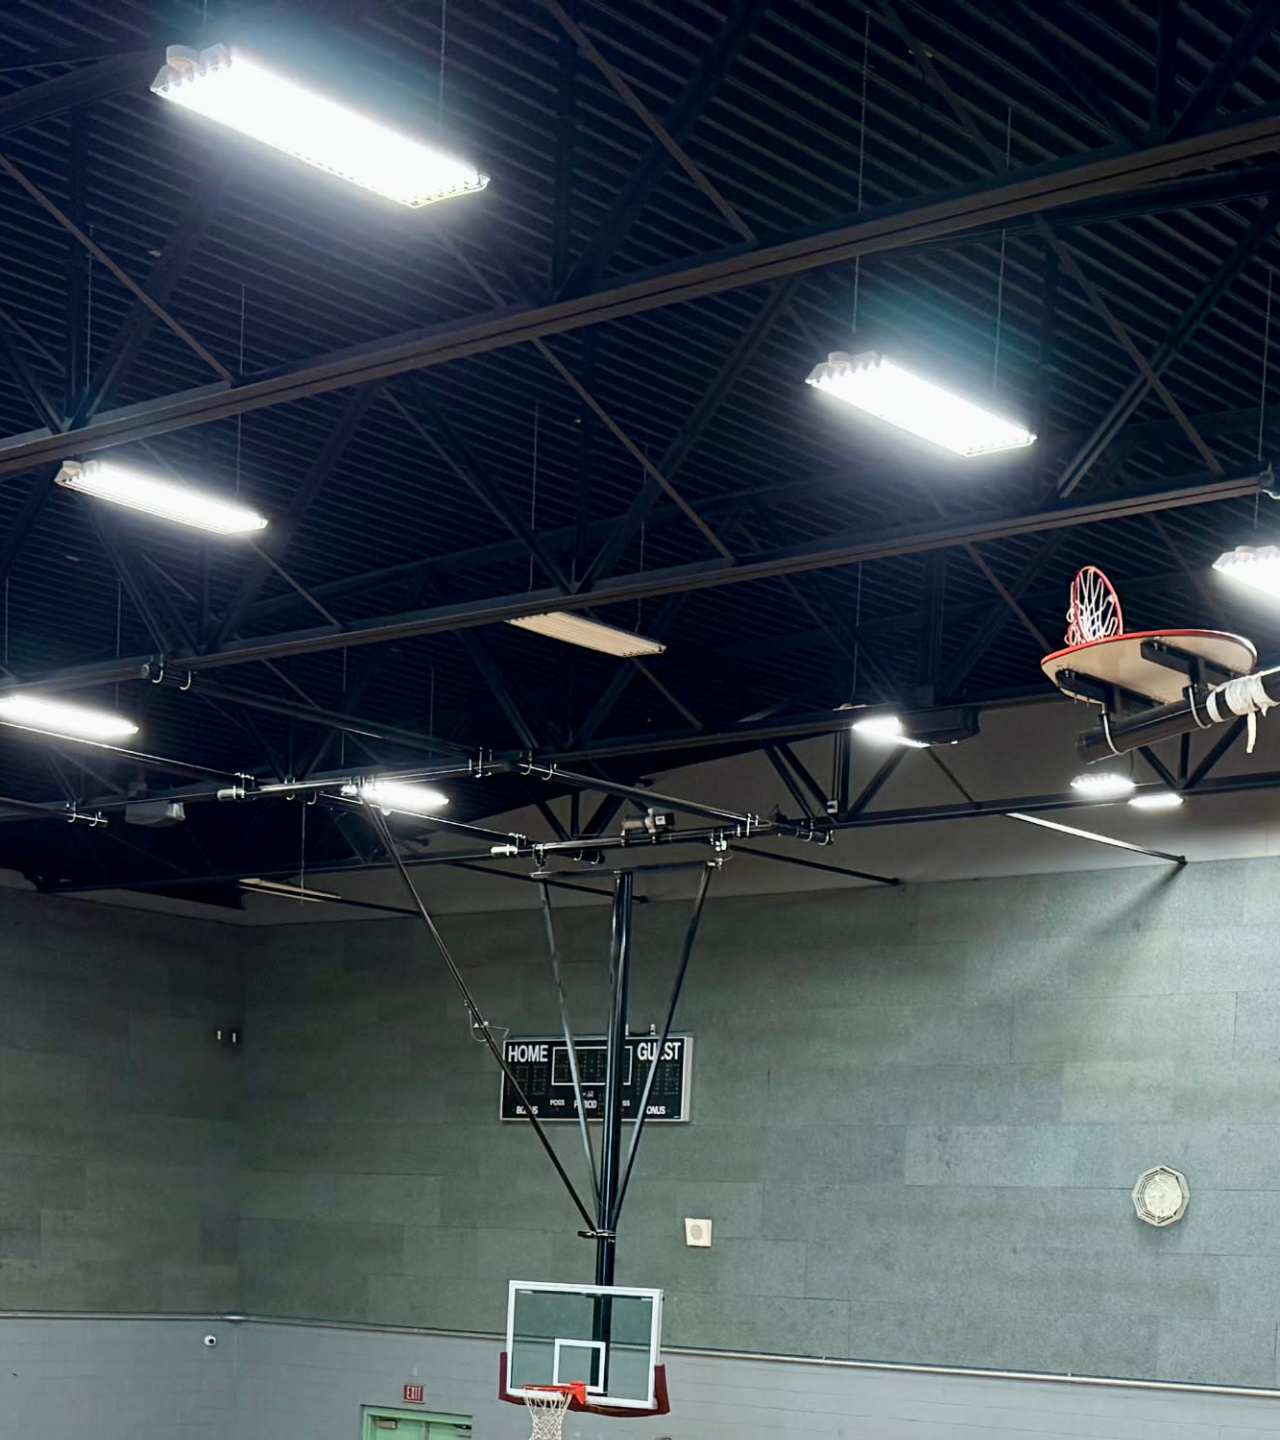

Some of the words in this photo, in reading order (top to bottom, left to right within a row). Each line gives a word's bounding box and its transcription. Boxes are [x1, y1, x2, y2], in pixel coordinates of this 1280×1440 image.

[507, 1044, 549, 1063] HOME
[636, 1041, 682, 1060] GUST
[645, 1105, 667, 1115] ONUS
[407, 1386, 422, 1401] EXIT
